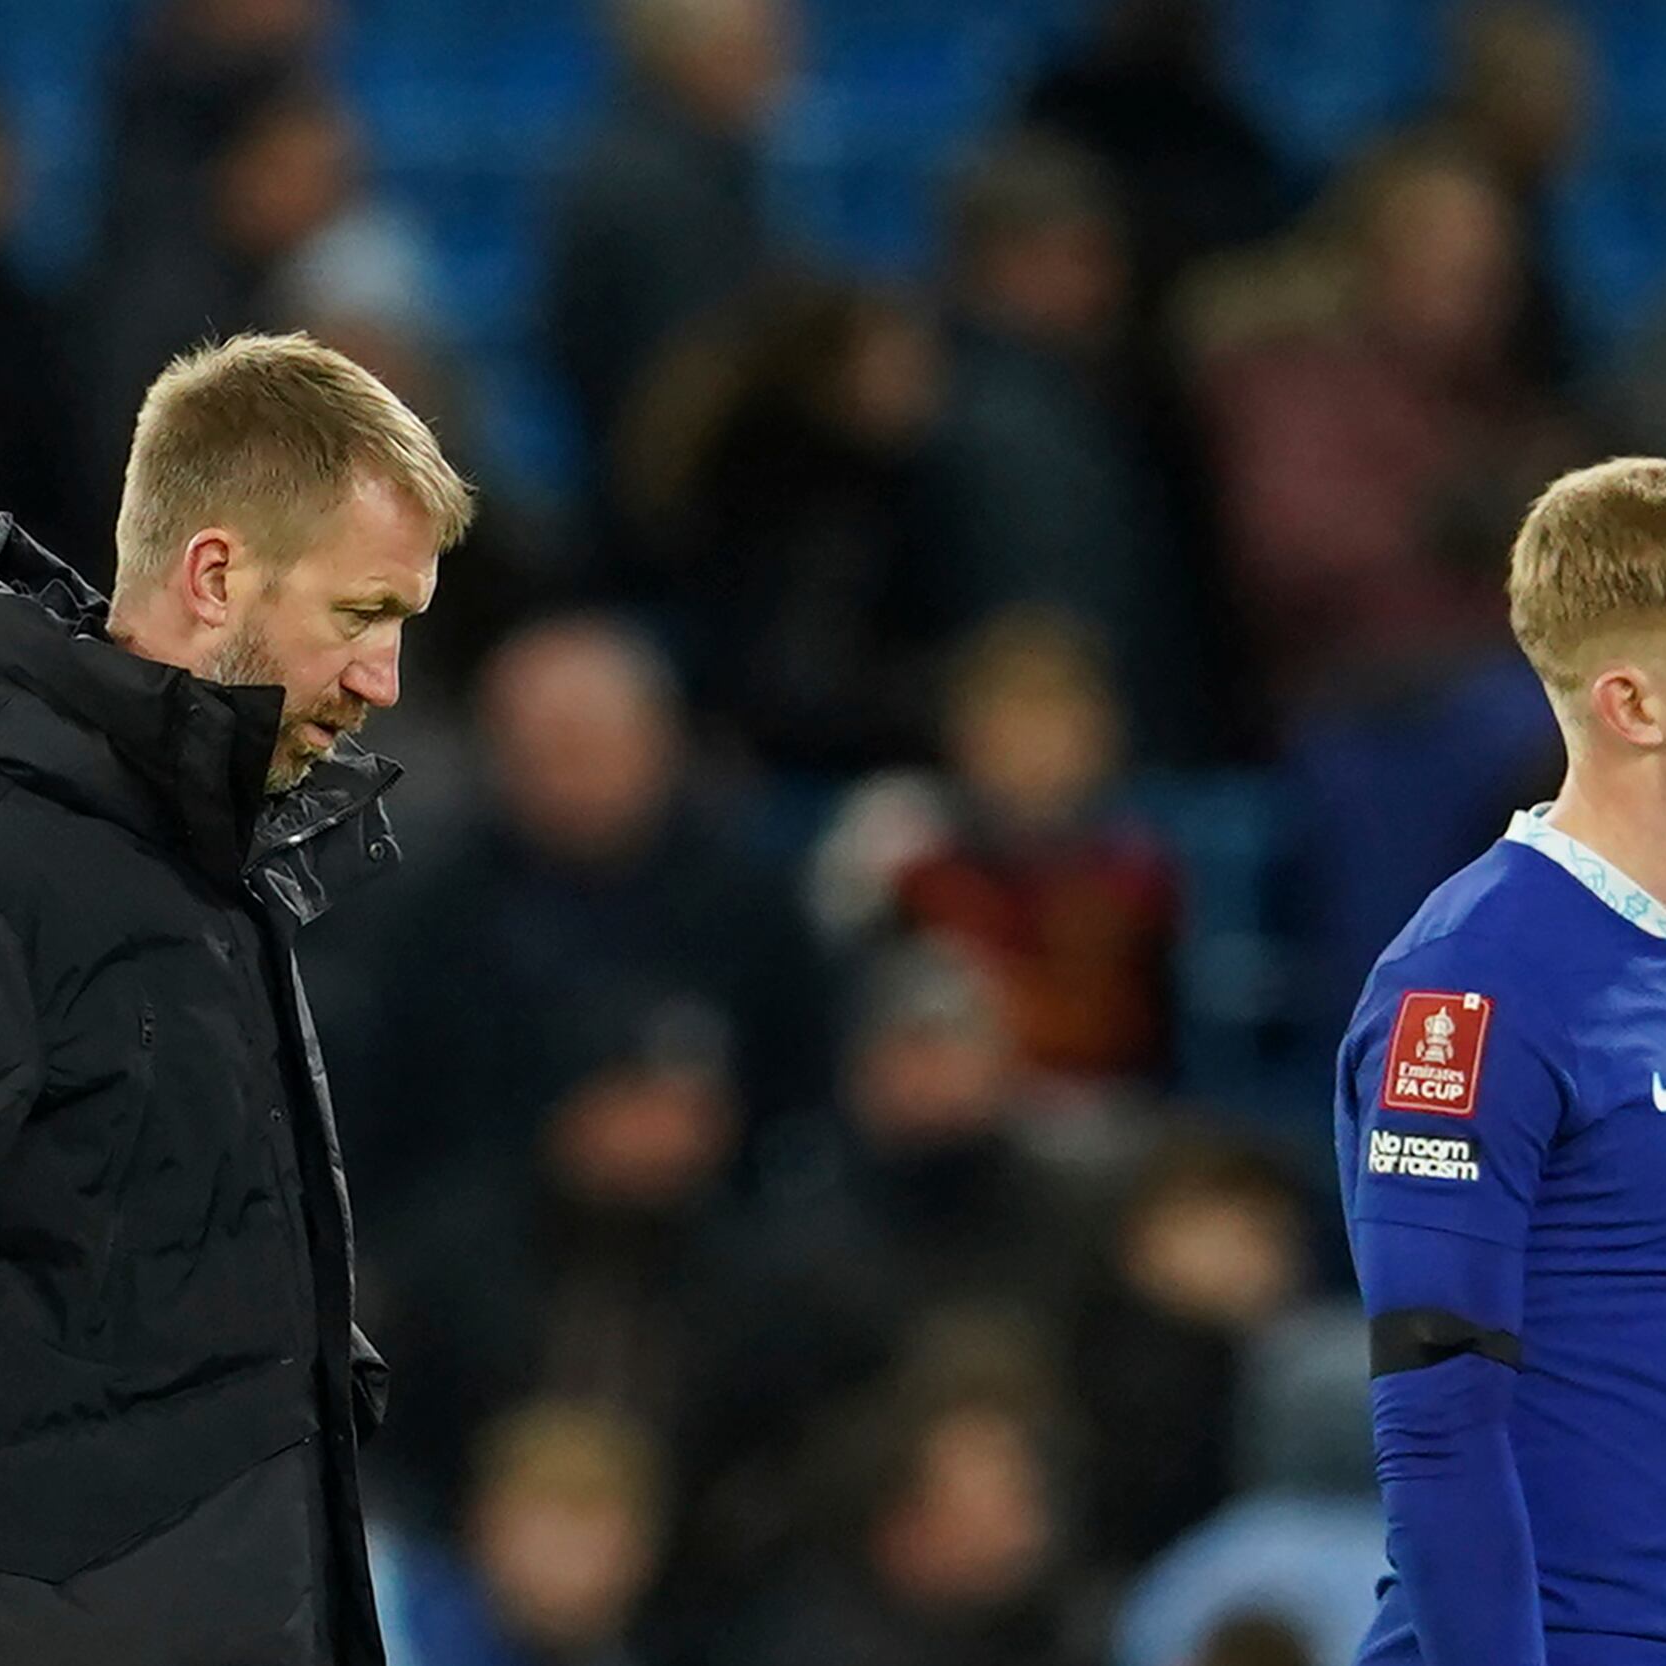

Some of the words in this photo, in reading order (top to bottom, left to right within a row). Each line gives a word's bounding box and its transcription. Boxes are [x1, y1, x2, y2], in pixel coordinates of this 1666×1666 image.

[1399, 1062, 1465, 1083] Emirates
[1395, 1078, 1420, 1097] FA
[1420, 1080, 1465, 1101] CUP
[1370, 1129, 1401, 1154] No
[1402, 1136, 1469, 1161] room
[1368, 1152, 1398, 1174] for
[1399, 1156, 1480, 1181] racism
